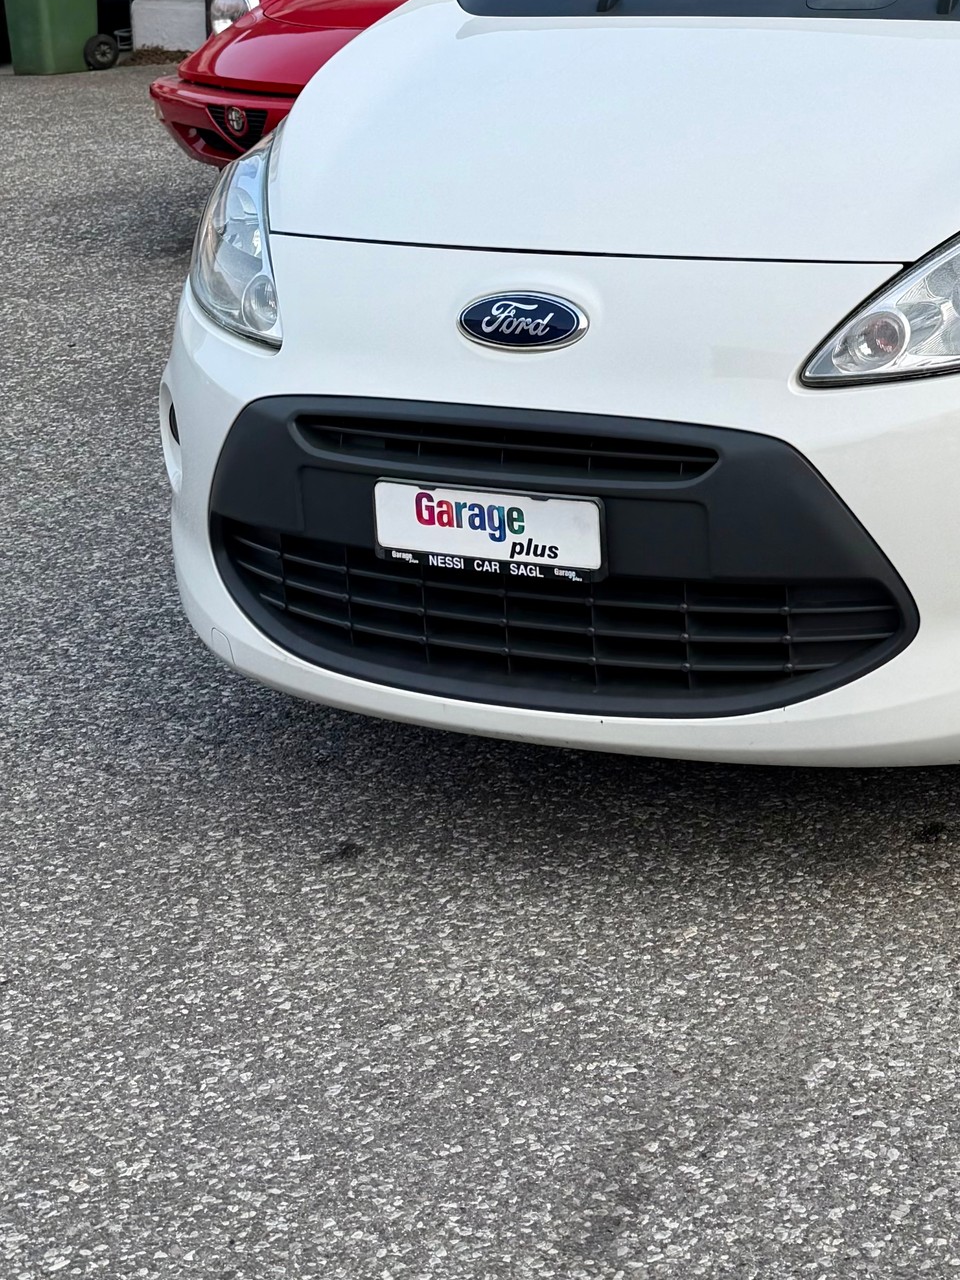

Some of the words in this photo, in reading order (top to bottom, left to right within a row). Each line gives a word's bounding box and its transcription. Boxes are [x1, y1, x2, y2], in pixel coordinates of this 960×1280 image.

[481, 300, 555, 336] Ford
[415, 492, 525, 542] Garage
[509, 538, 560, 560] plus
[428, 554, 465, 570] NESSI
[473, 559, 500, 574] CAR
[509, 563, 545, 578] SAGL
